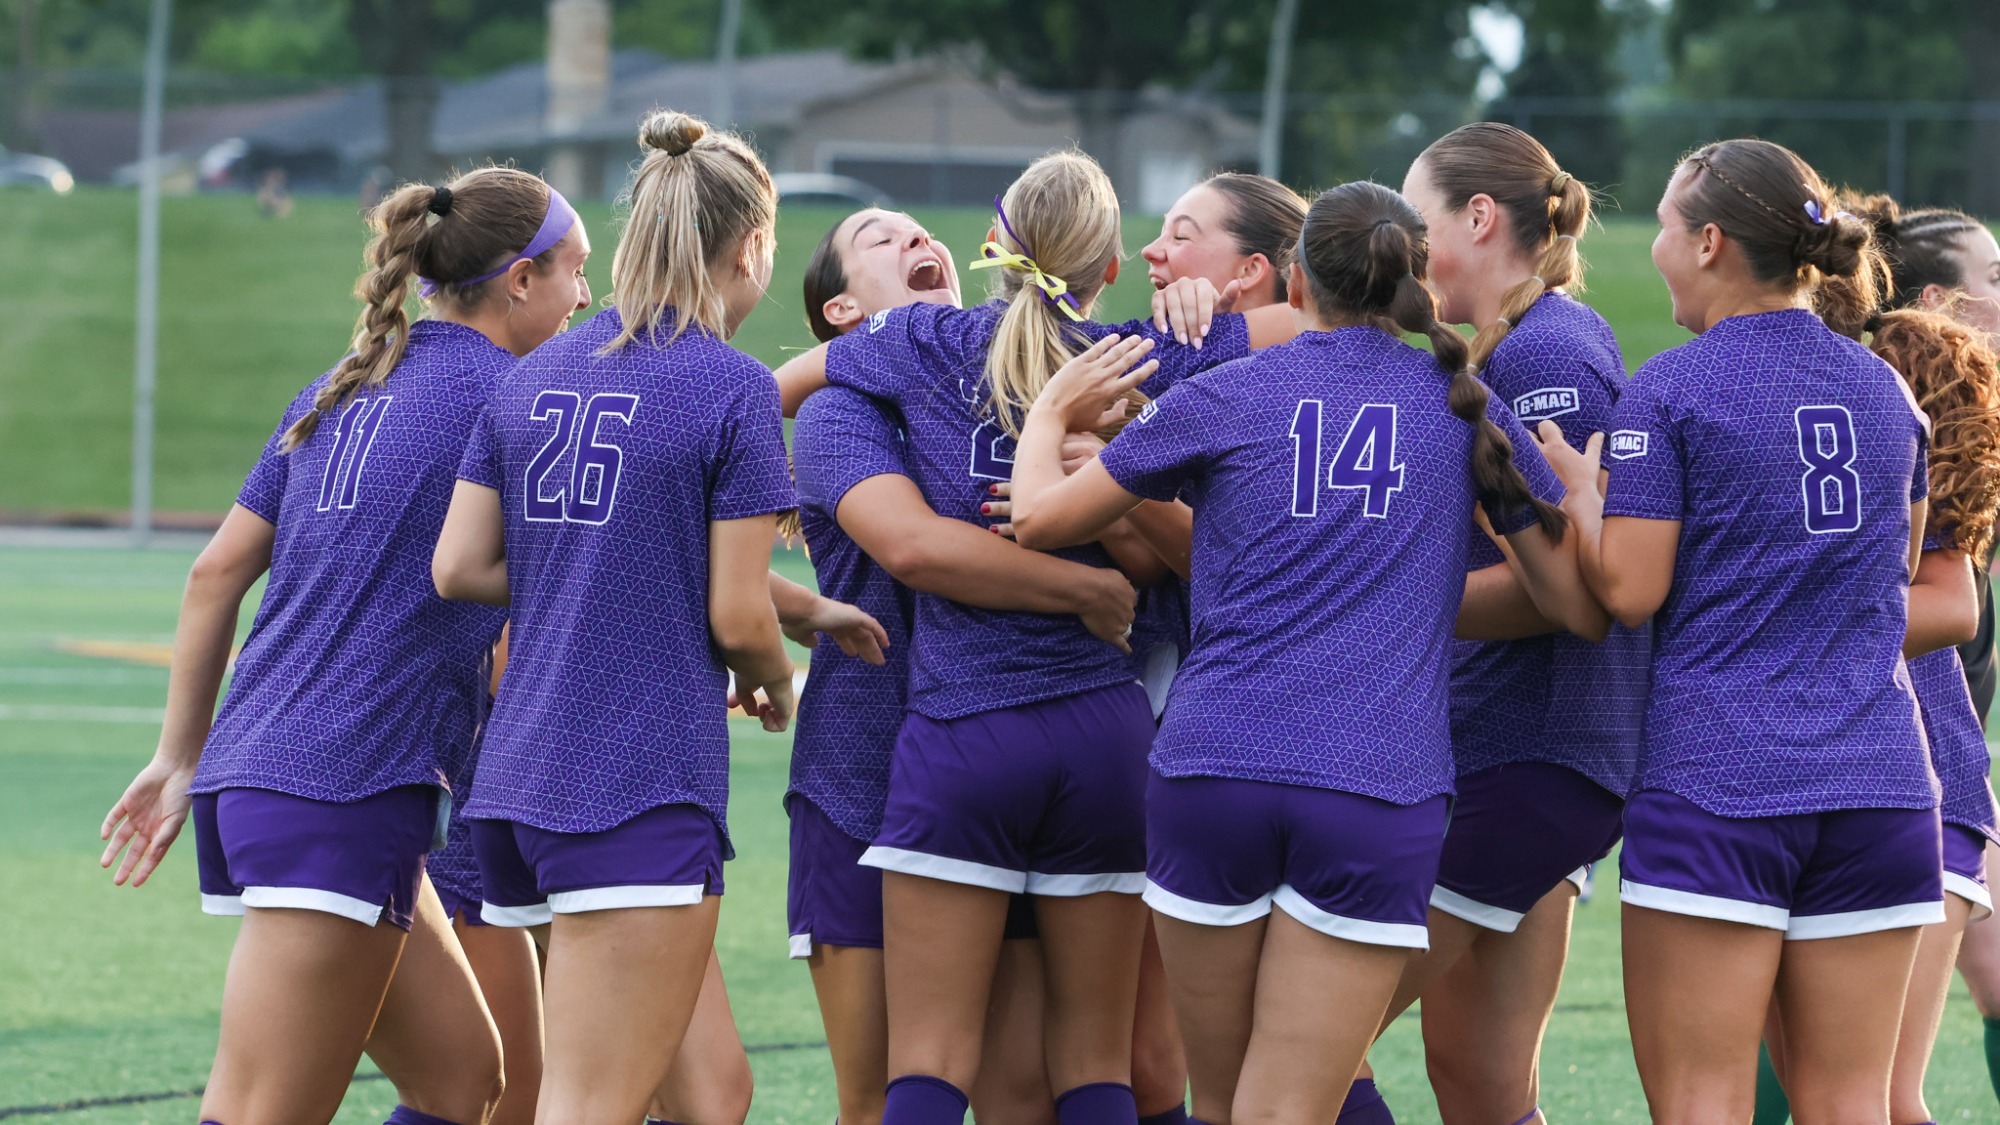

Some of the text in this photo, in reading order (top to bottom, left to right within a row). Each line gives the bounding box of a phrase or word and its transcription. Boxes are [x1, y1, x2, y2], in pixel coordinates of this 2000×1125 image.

[317, 396, 392, 511] 11
[525, 391, 639, 525] 26
[1288, 399, 1405, 519] 14
[1795, 405, 1861, 534] 8
